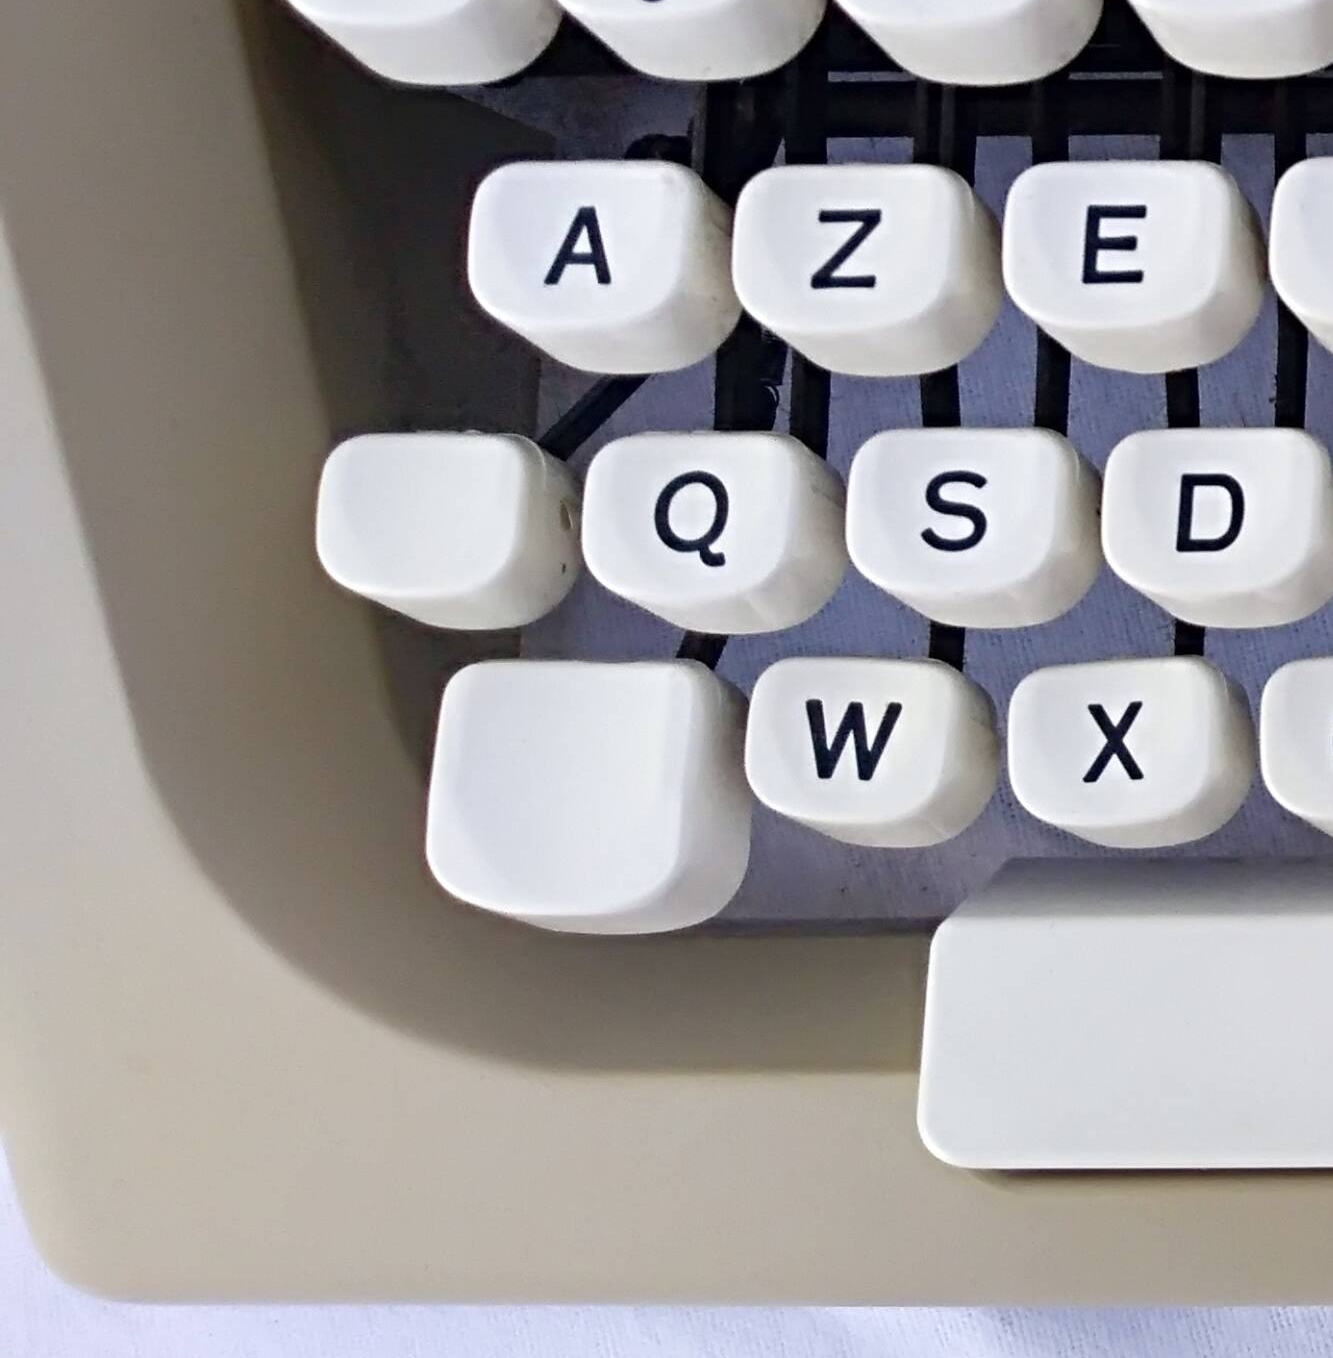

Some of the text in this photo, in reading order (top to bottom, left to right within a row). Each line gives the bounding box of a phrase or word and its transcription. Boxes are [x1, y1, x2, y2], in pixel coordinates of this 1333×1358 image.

[544, 207, 611, 285] A
[811, 209, 881, 289] Z
[1082, 205, 1147, 284] E
[654, 471, 728, 567] Q
[921, 471, 987, 552] S
[1176, 474, 1244, 552] D
[806, 699, 902, 781] W
[1083, 701, 1143, 783] X
